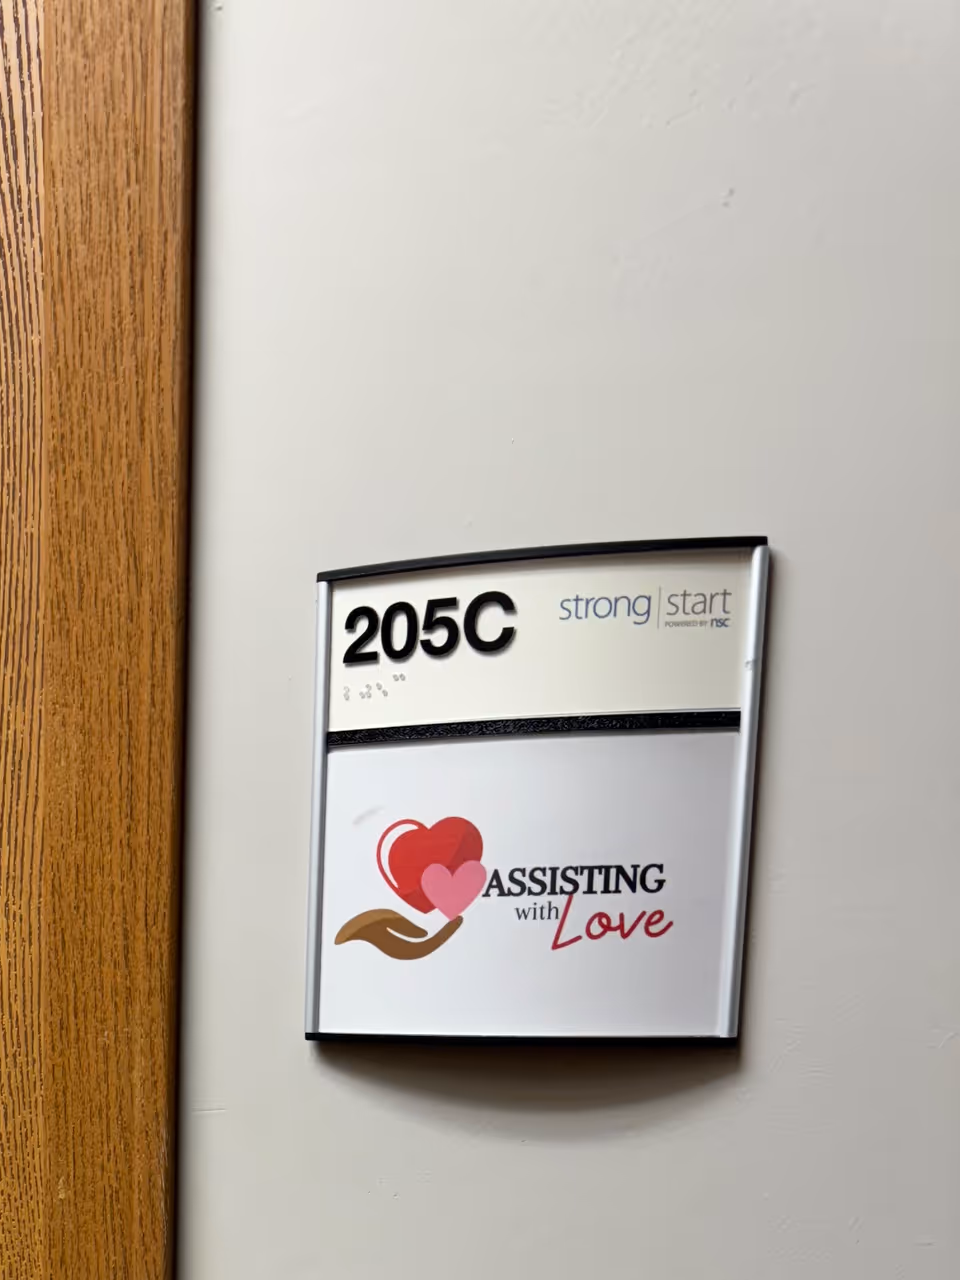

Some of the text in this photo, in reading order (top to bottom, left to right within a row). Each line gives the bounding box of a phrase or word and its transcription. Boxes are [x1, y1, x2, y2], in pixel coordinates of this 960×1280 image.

[559, 588, 732, 625] strong start
[710, 617, 730, 628] nsc
[342, 590, 517, 665] 205C
[482, 863, 666, 898] ASSISTING
[514, 894, 673, 951] with Love
